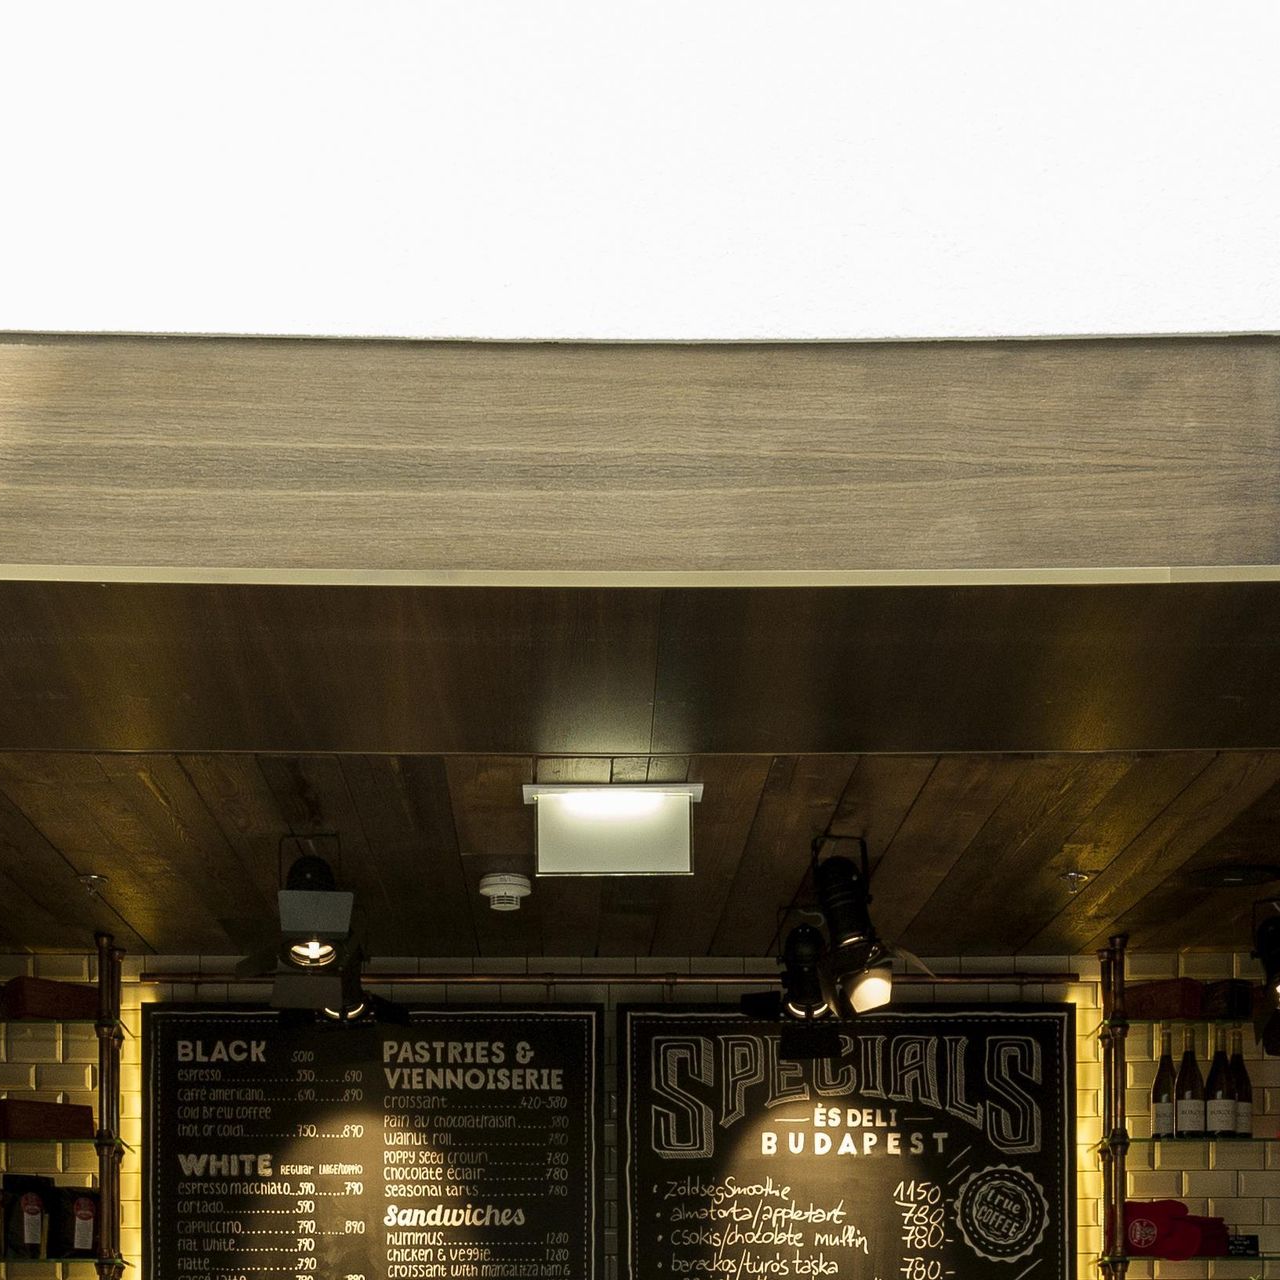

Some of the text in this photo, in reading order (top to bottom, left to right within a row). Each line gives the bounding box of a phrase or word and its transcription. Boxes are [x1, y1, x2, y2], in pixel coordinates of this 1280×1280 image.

[177, 1040, 266, 1062] BLACK
[383, 1041, 535, 1064] PASTRIES &
[296, 1070, 315, 1082] 550
[344, 1070, 362, 1082] 690
[384, 1068, 563, 1090] VIENNOISERIE
[344, 1088, 363, 1101] 890
[651, 1034, 1042, 1159] SPECIALS
[549, 1115, 569, 1128] 580
[814, 1103, 897, 1127] ÉS DELI
[297, 1125, 317, 1138] 750
[344, 1125, 364, 1138] 890
[761, 1131, 949, 1155] BUDAPEST
[547, 1152, 569, 1165] 780
[178, 1154, 273, 1177] WHITE
[545, 1168, 568, 1180] 780
[298, 1182, 315, 1195] 590
[344, 1182, 363, 1195] 790
[548, 1185, 567, 1196] 780
[296, 1200, 315, 1213] 590
[384, 1204, 526, 1227] Sandwiches
[978, 1206, 1019, 1237] COFFEE
[297, 1221, 316, 1234] 790
[345, 1221, 365, 1234] 890
[297, 1238, 315, 1251] 790
[547, 1232, 569, 1244] 1280
[437, 1249, 446, 1261] &
[546, 1249, 569, 1261] 1280
[297, 1258, 317, 1270] 790
